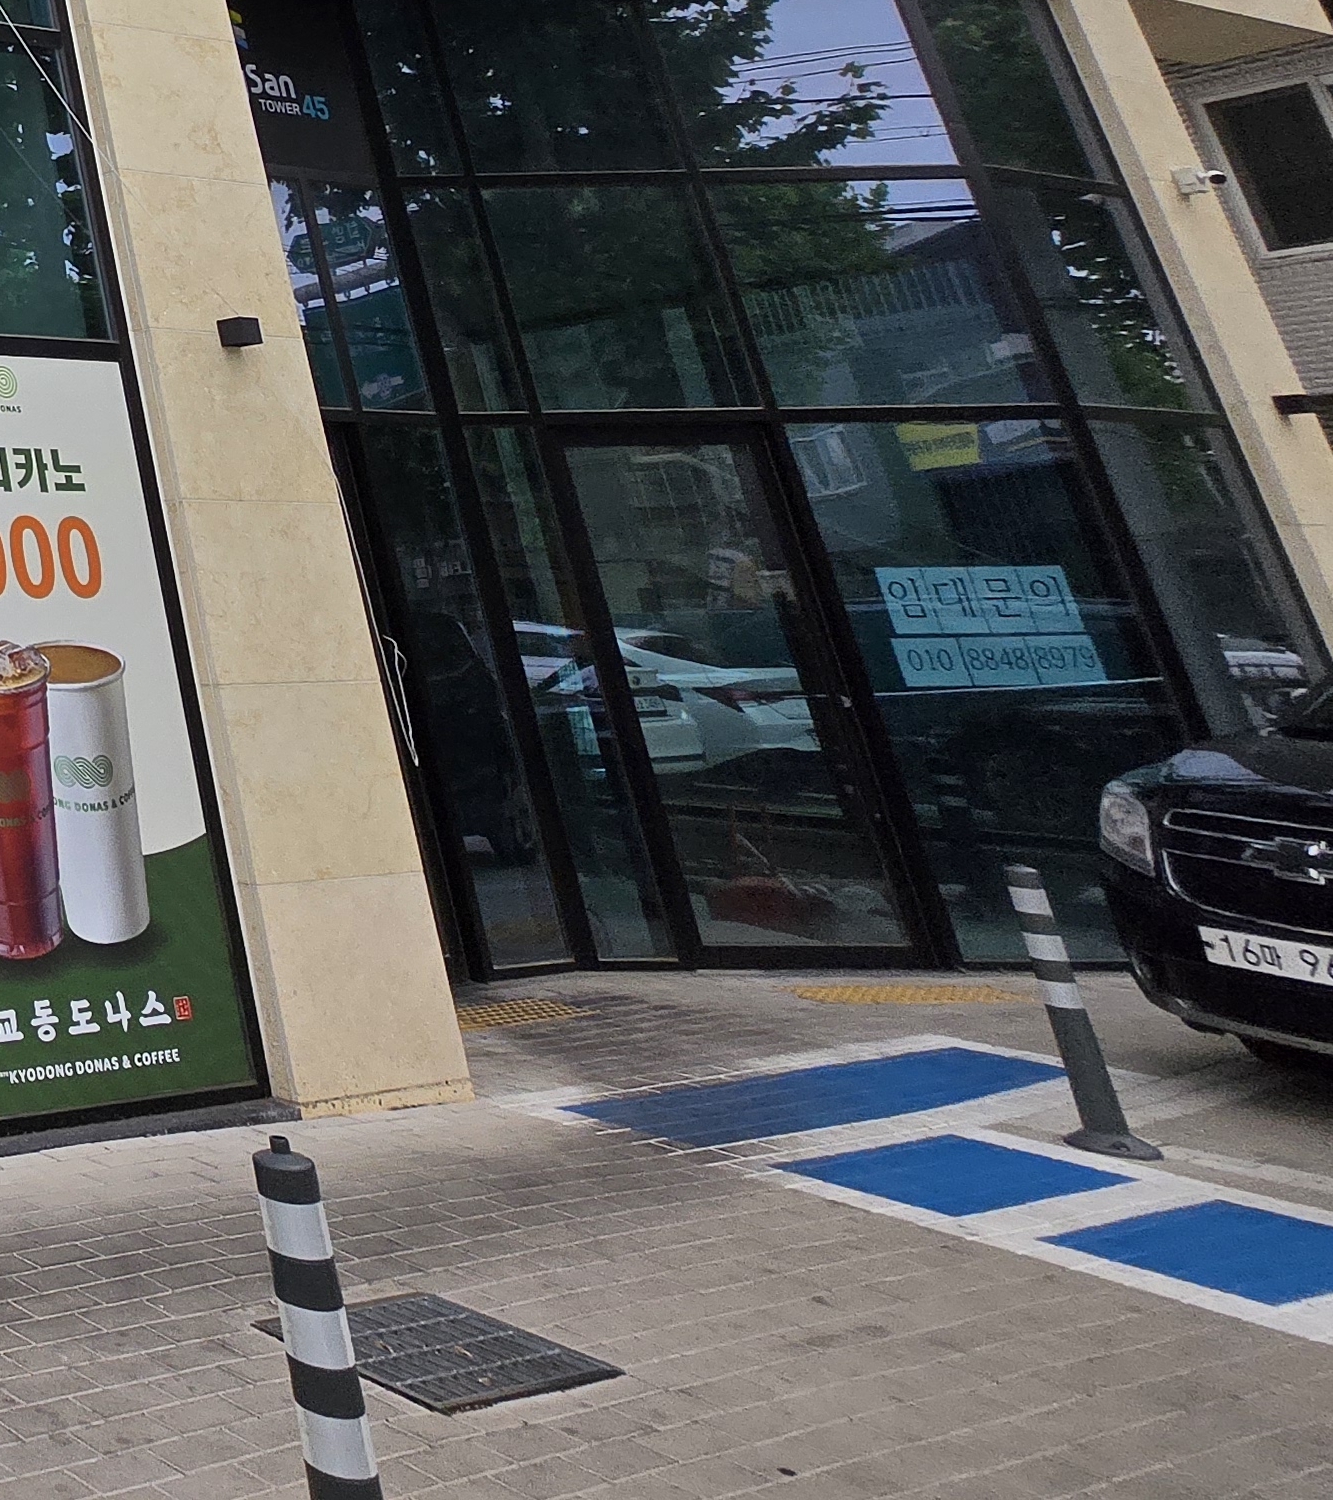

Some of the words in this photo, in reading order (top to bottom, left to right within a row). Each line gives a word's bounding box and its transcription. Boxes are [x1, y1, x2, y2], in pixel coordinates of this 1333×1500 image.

[259, 98, 302, 116] TOWER
[303, 94, 329, 120] 45
[887, 574, 1071, 618] 임대문의
[907, 648, 954, 672] 010
[968, 647, 1029, 671] 8848
[1036, 646, 1097, 670] 8979
[1218, 934, 1283, 971] 16마
[8, 1062, 74, 1085] KYODONG
[75, 1056, 119, 1076] DONAS
[121, 1054, 132, 1070] &
[134, 1048, 181, 1068] COFFEE
